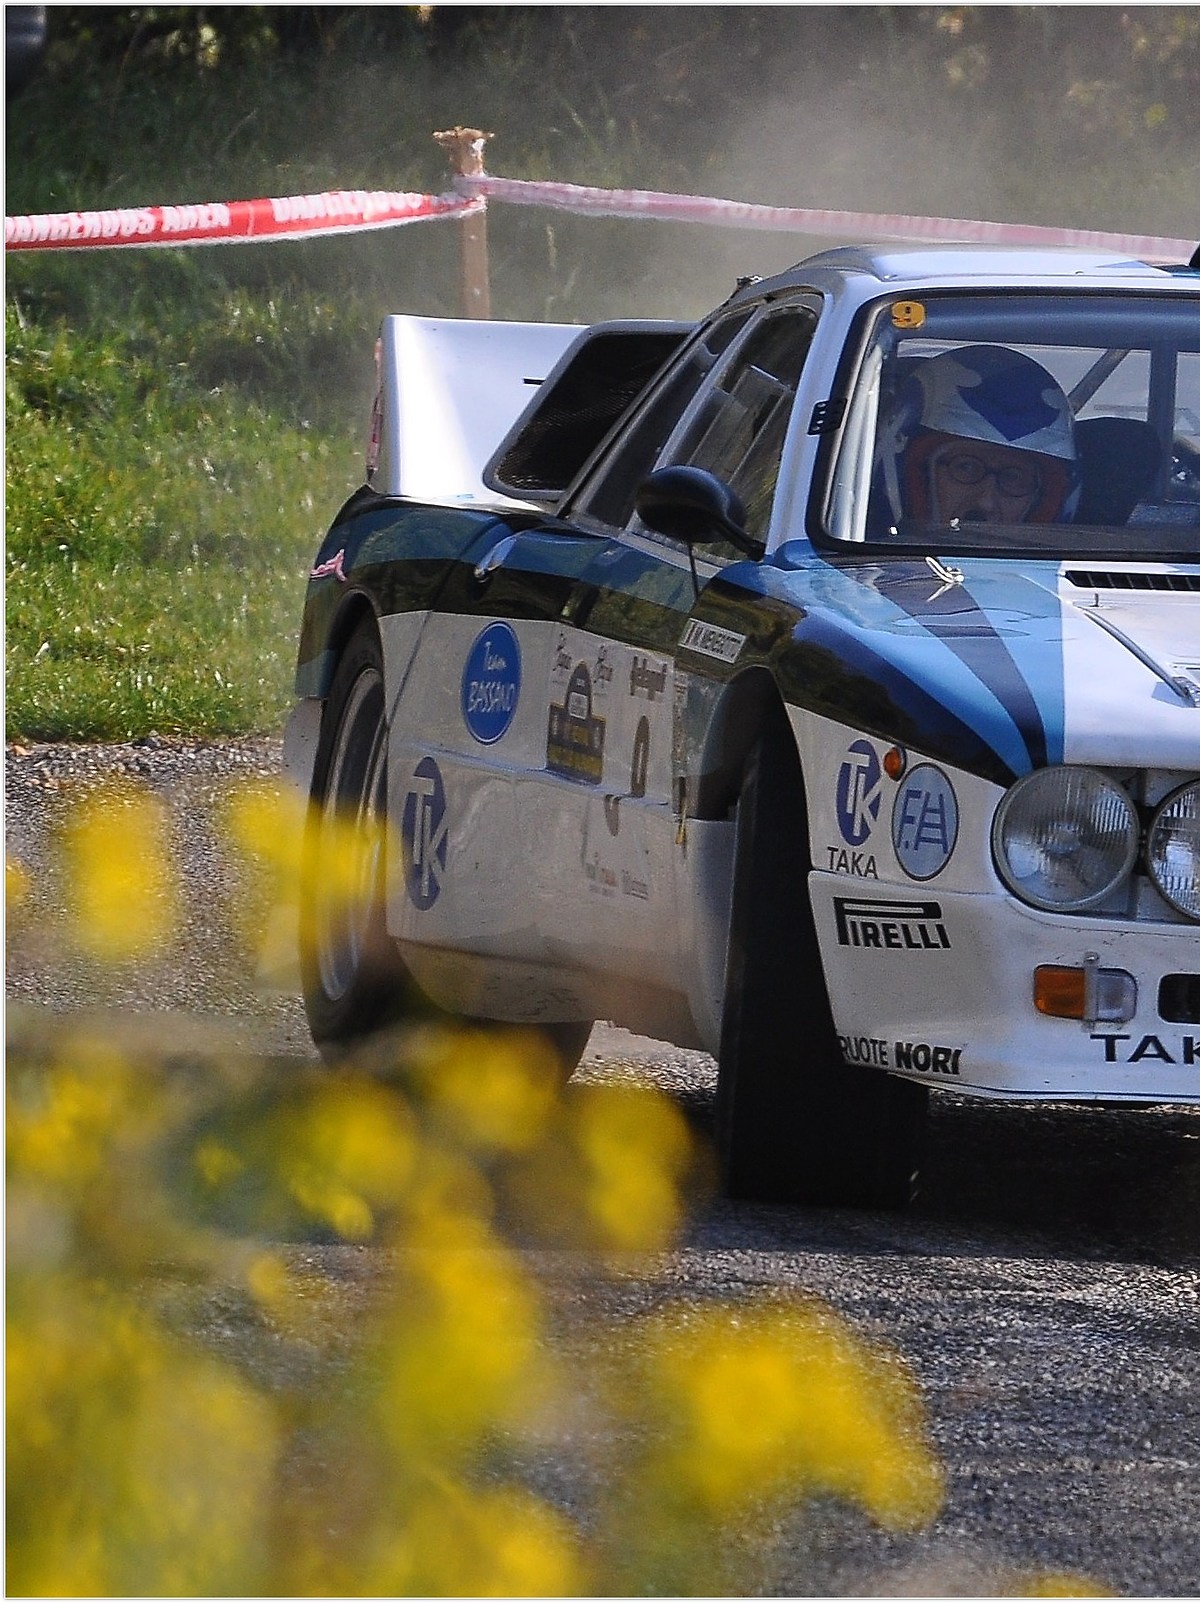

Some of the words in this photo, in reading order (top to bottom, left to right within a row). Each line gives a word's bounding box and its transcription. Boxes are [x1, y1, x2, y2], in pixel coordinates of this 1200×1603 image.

[827, 846, 879, 880] TAKA
[832, 897, 951, 949] PIRELLI
[839, 1035, 889, 1067] RUOTE
[895, 1042, 962, 1076] NORI
